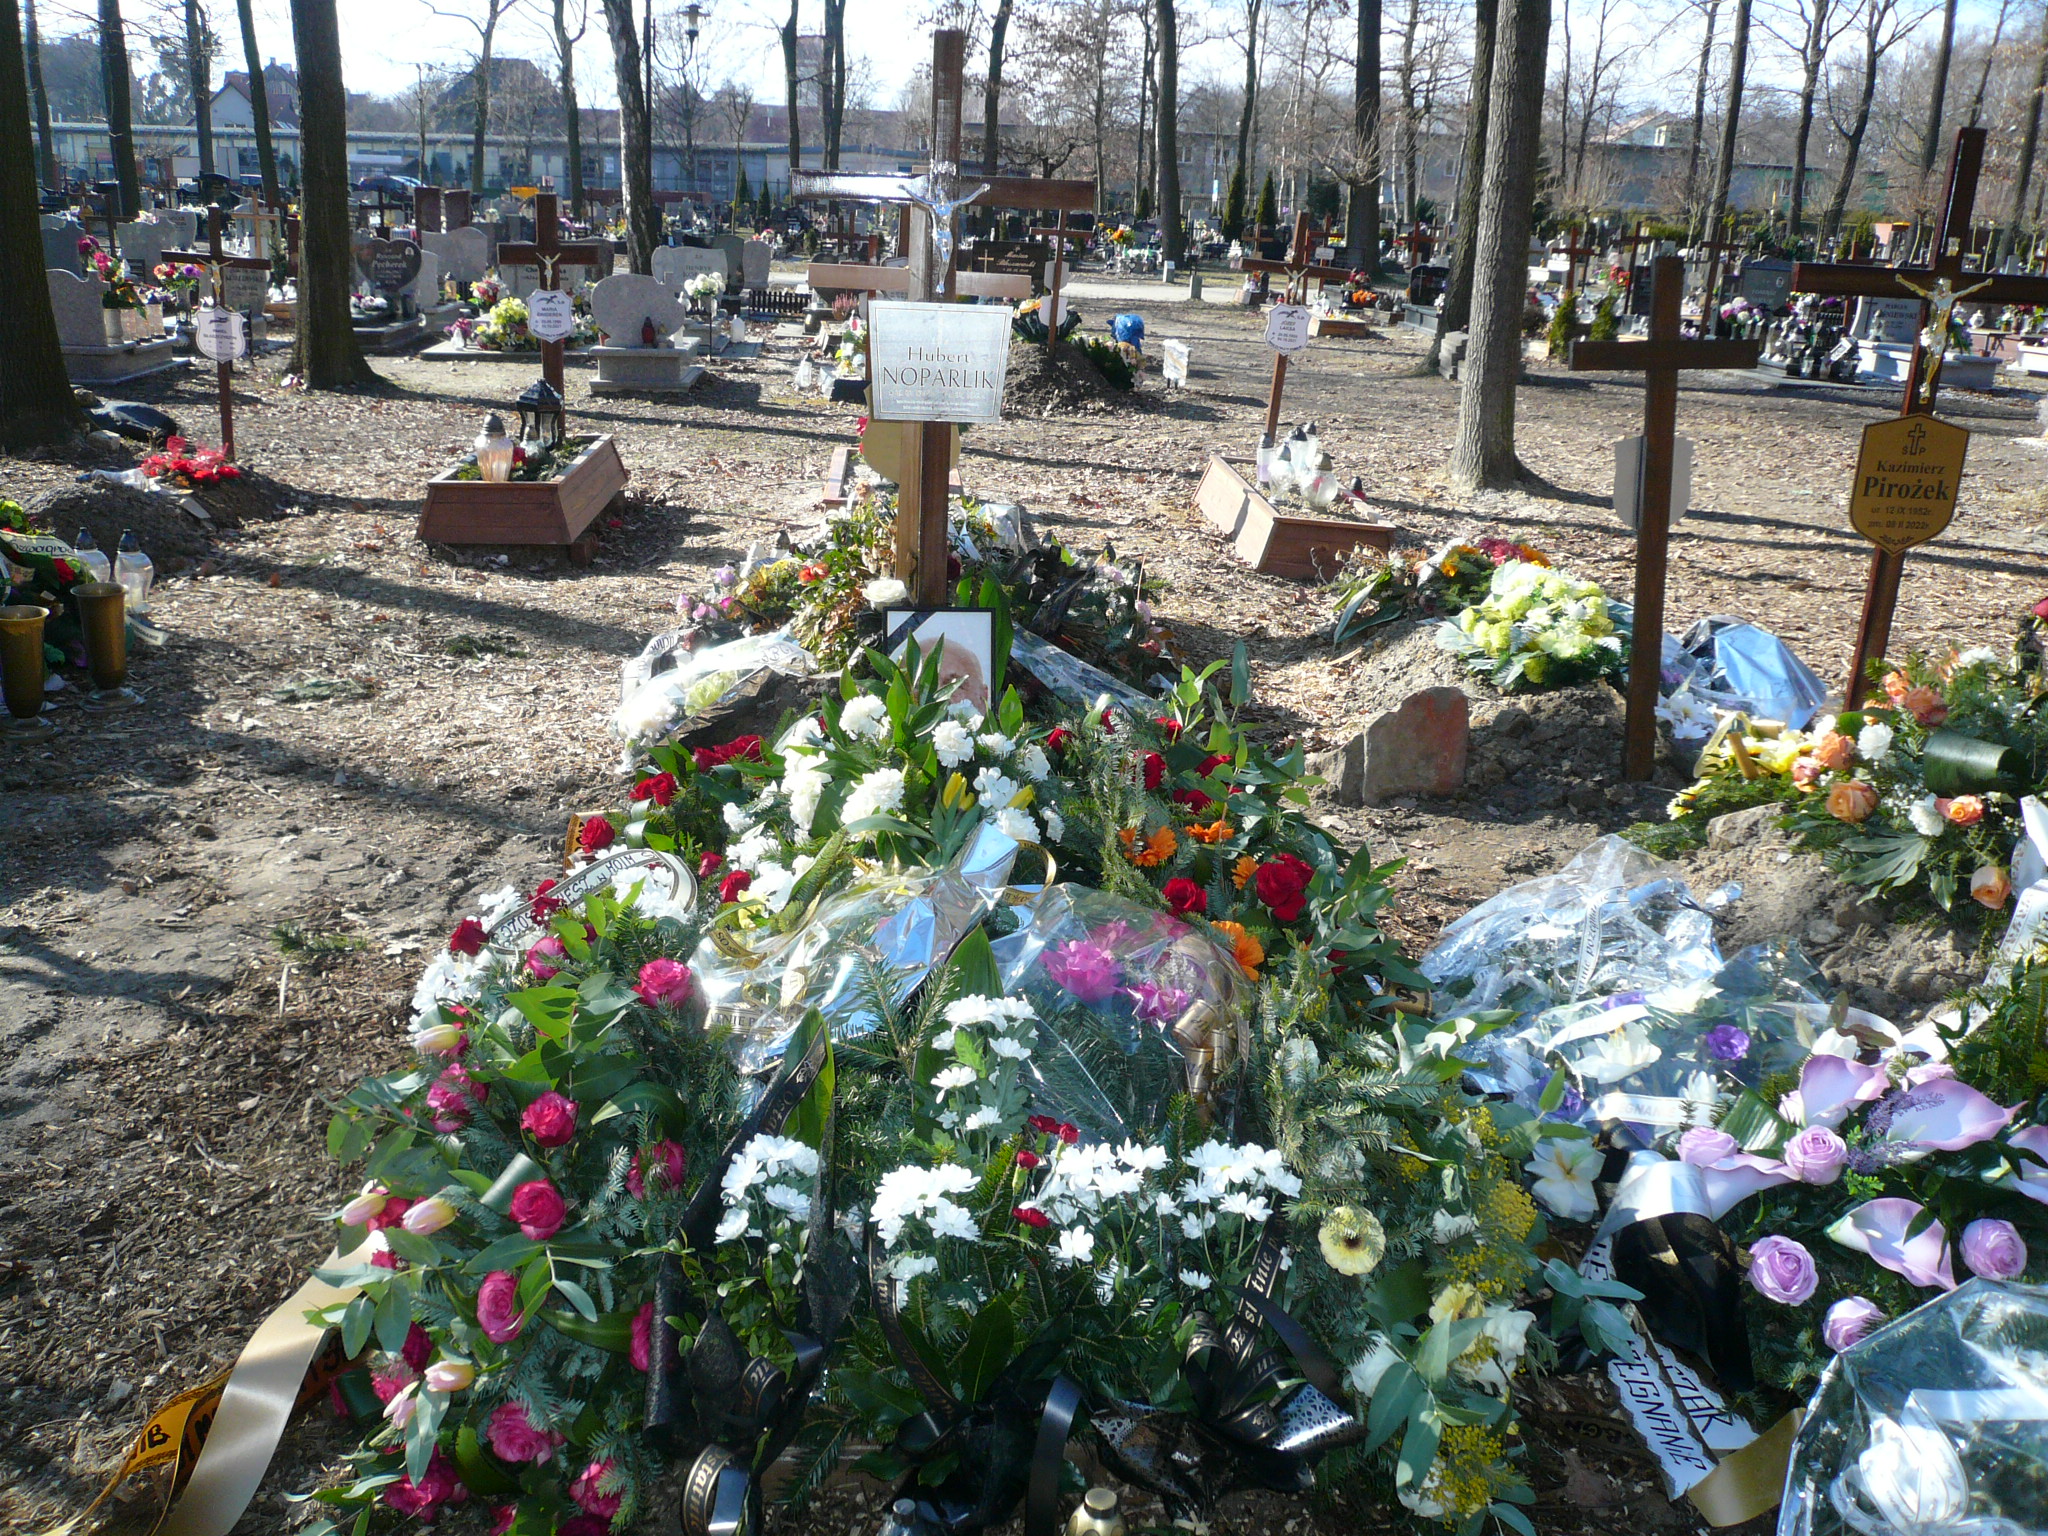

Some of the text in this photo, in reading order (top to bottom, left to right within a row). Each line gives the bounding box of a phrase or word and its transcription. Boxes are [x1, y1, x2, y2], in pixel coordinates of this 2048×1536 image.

[908, 346, 969, 363] Hubert
[883, 366, 994, 389] NOPARLIK
[1877, 461, 1946, 475] Kazimierz
[1863, 476, 1951, 500] Pirożek
